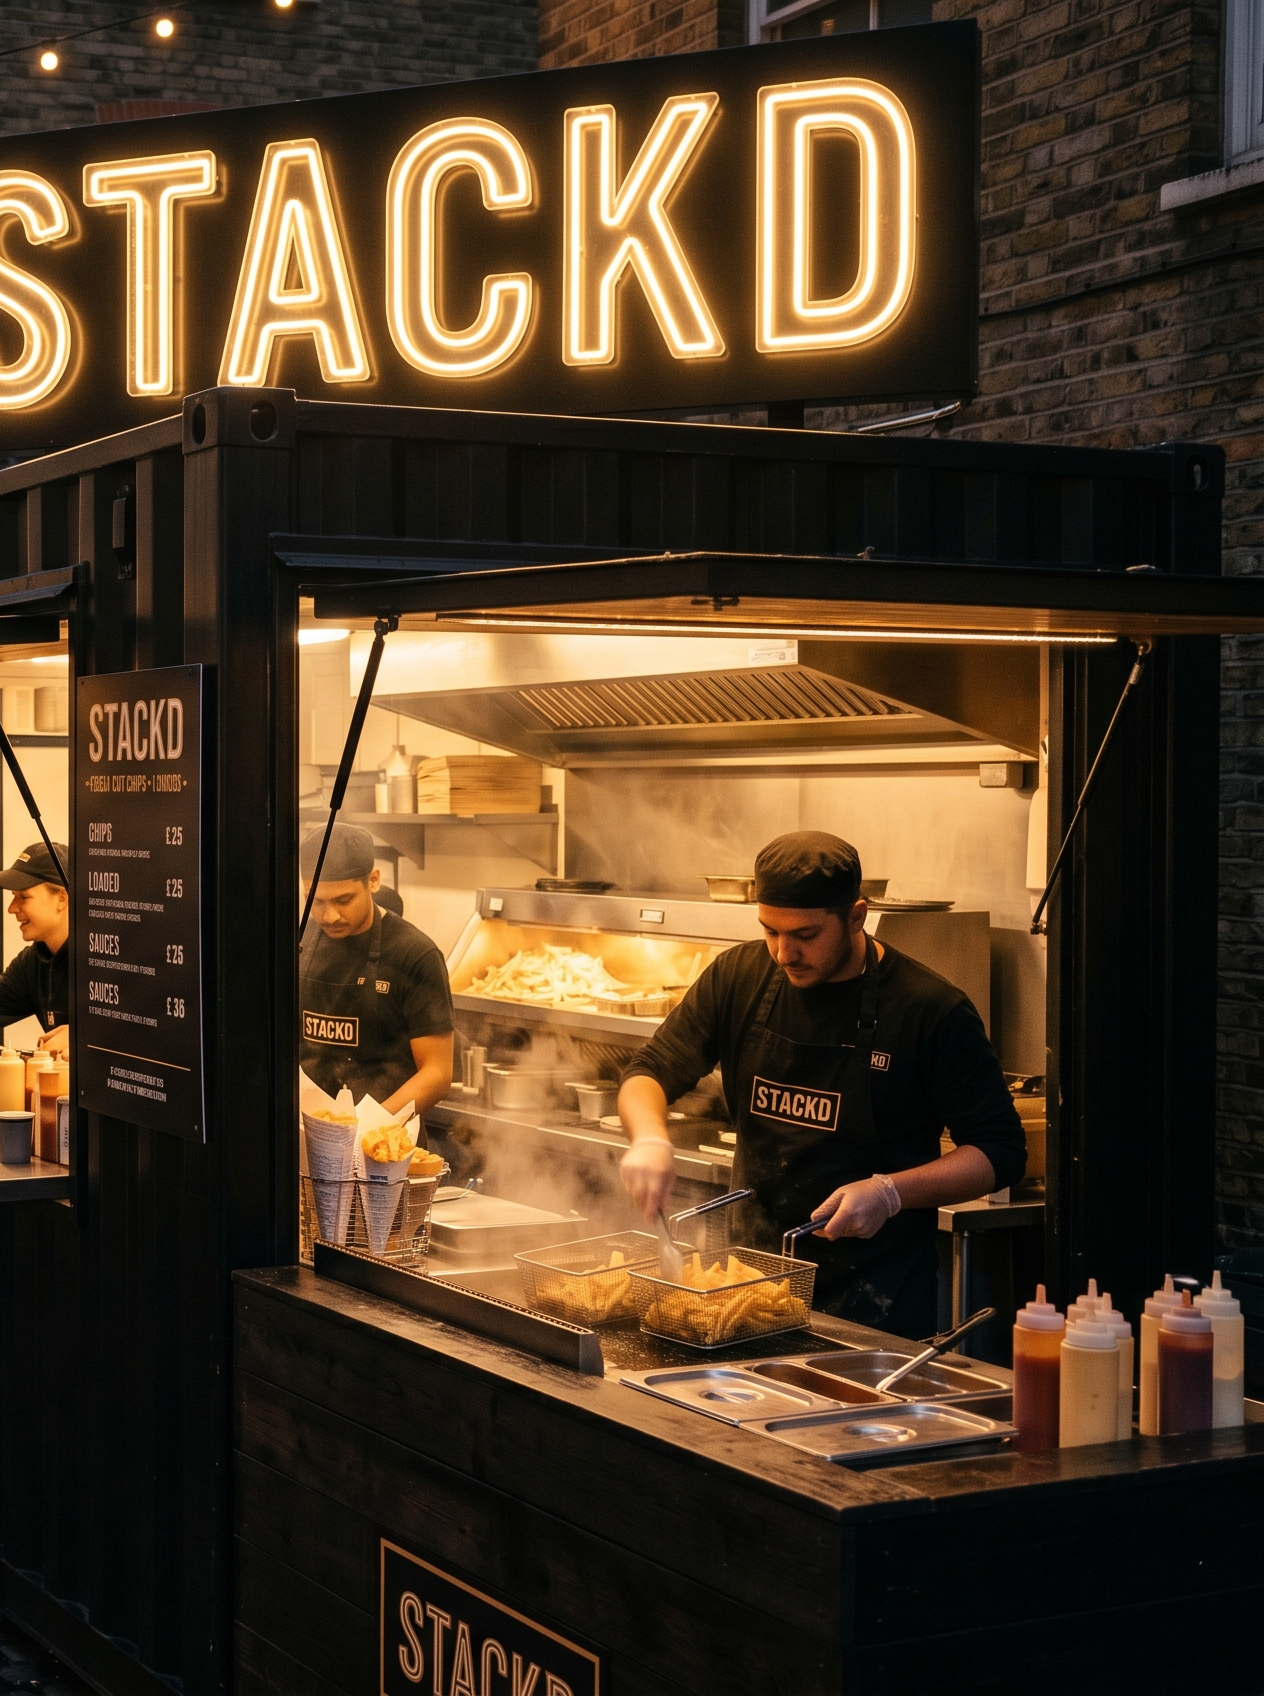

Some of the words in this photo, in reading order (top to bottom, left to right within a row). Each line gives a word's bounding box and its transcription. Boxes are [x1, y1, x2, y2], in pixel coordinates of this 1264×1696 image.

[89, 697, 184, 763] STACKD
[88, 822, 112, 842] CHIPS
[88, 871, 119, 892] LOADED
[89, 932, 119, 955] SAUCES
[89, 980, 119, 1004] SAUCES
[756, 1085, 831, 1122] STACKD
[398, 1590, 575, 1696] STAC
